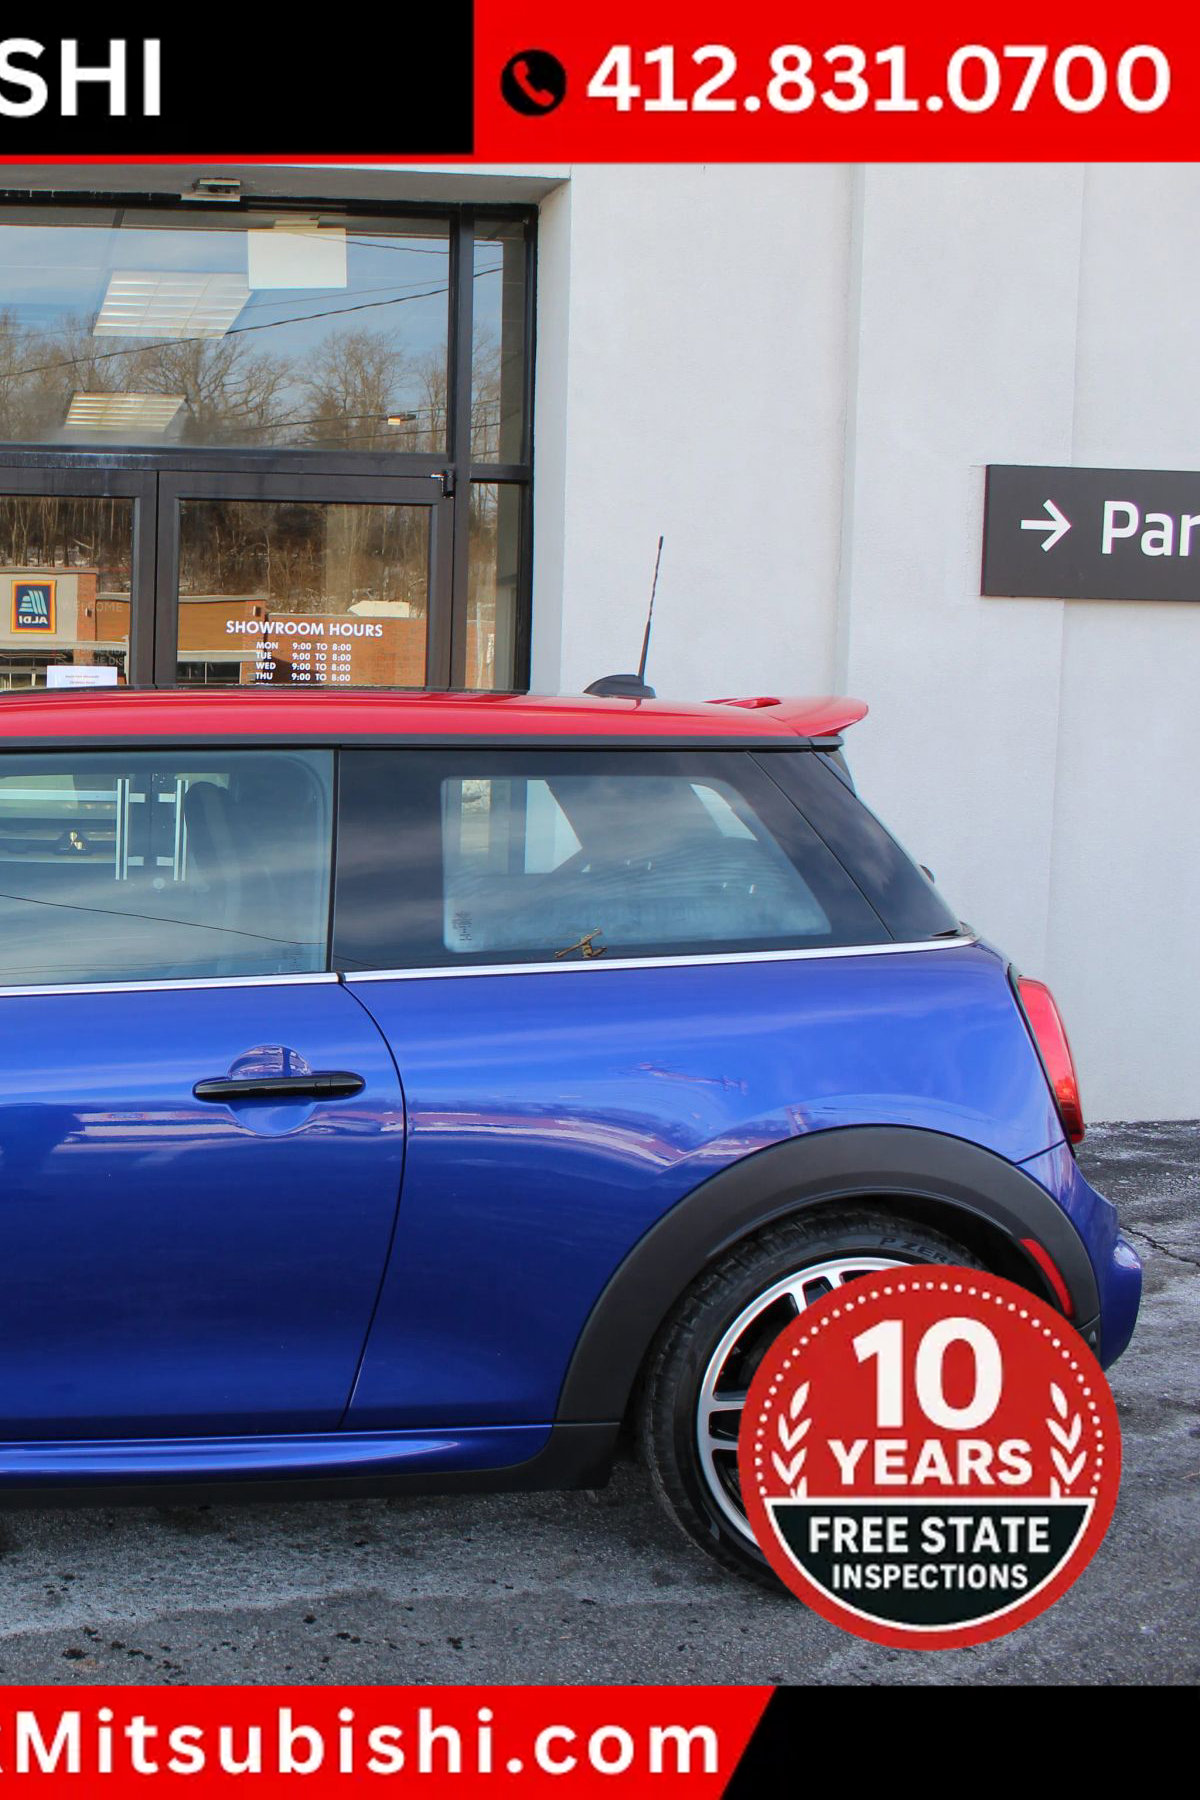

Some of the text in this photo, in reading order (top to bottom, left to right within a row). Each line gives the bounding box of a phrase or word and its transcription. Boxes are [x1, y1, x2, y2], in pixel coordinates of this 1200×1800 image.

[1101, 500, 1200, 557] Par
[226, 620, 383, 637] SHOWROOM HOURS
[256, 642, 279, 650] MON
[292, 643, 312, 651] 9:00
[316, 643, 328, 651] TO
[256, 652, 272, 660] TUE
[291, 652, 311, 660] 9:00
[315, 653, 327, 661] TO
[256, 662, 277, 670] WED
[291, 662, 311, 671] 9:00
[315, 663, 327, 671] TO
[256, 672, 273, 680] THU
[291, 672, 311, 681] 9:00
[315, 673, 327, 681] TO
